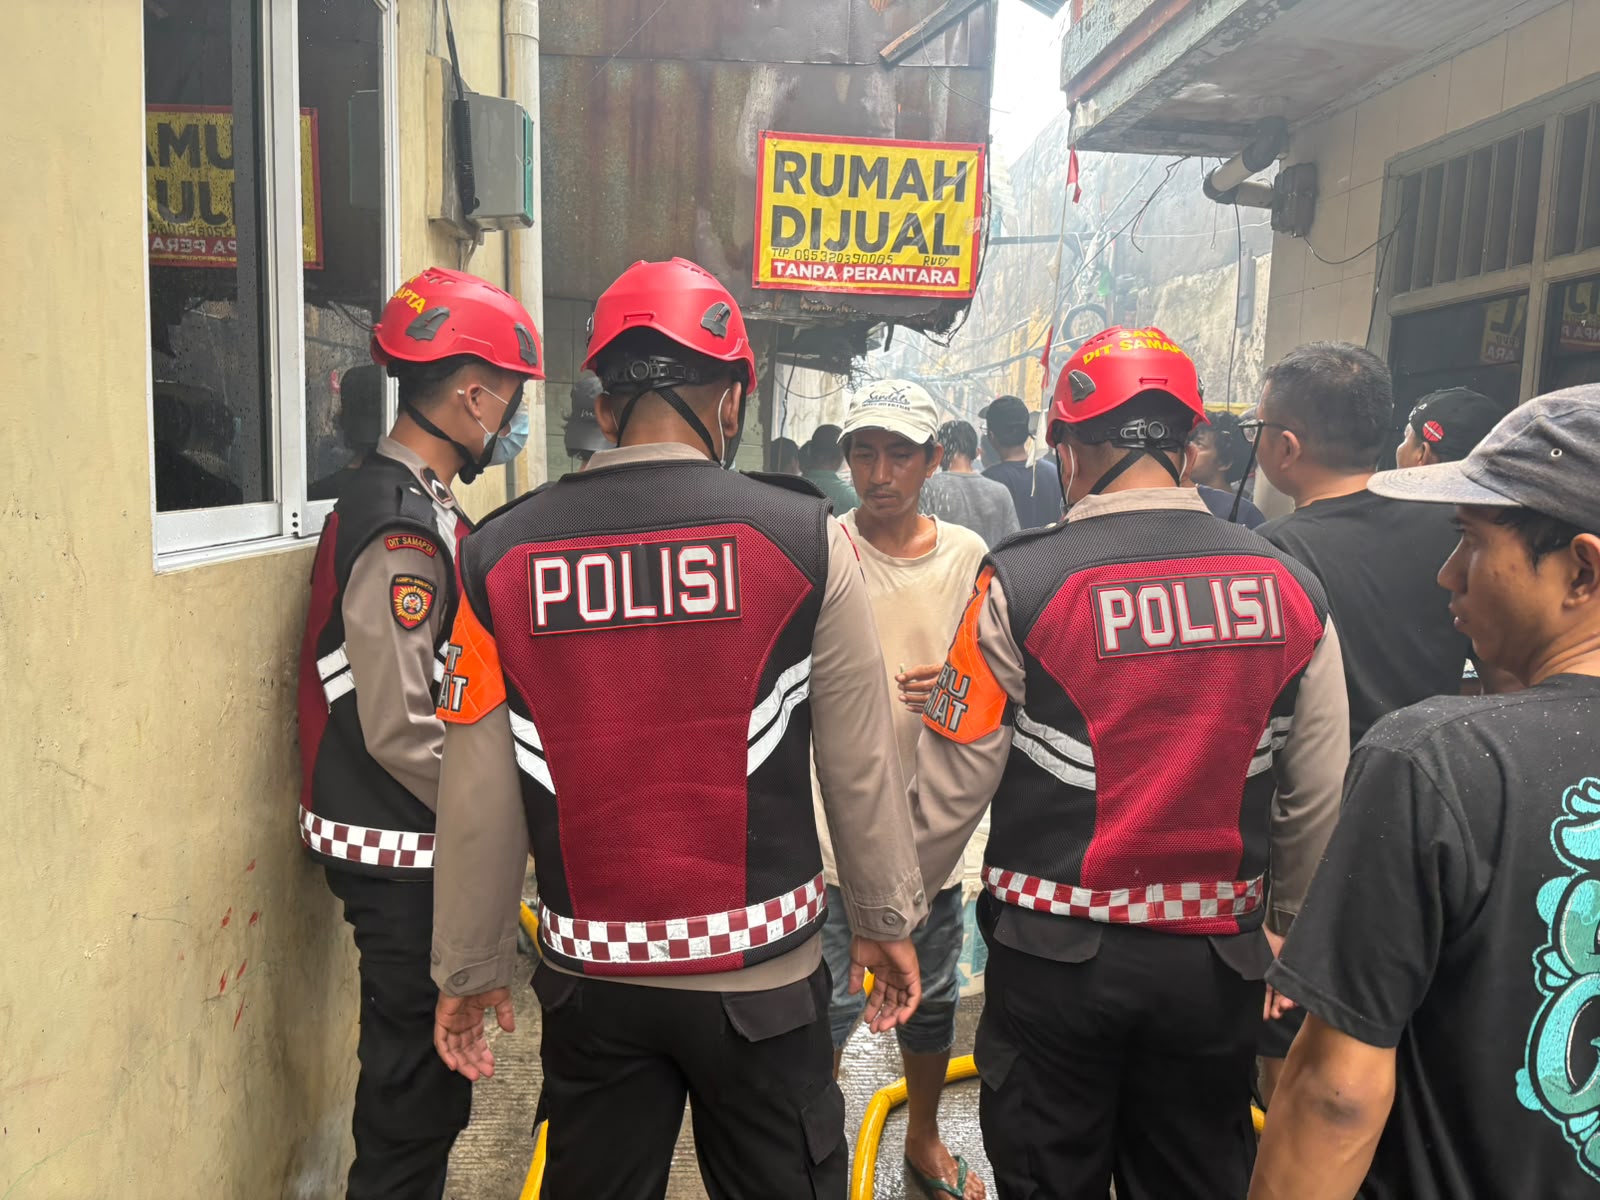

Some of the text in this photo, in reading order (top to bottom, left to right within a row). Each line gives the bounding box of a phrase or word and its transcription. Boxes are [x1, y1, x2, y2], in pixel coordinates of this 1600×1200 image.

[773, 150, 968, 202] RUMAH
[771, 205, 960, 256] DIJUAL
[774, 261, 956, 284] TANPA PERANTARA
[1119, 331, 1162, 340] SAR
[1082, 344, 1113, 365] DIT
[388, 536, 433, 553] DIT SAMAPTA
[533, 543, 736, 627] POLISI
[1097, 576, 1282, 652] POLISI
